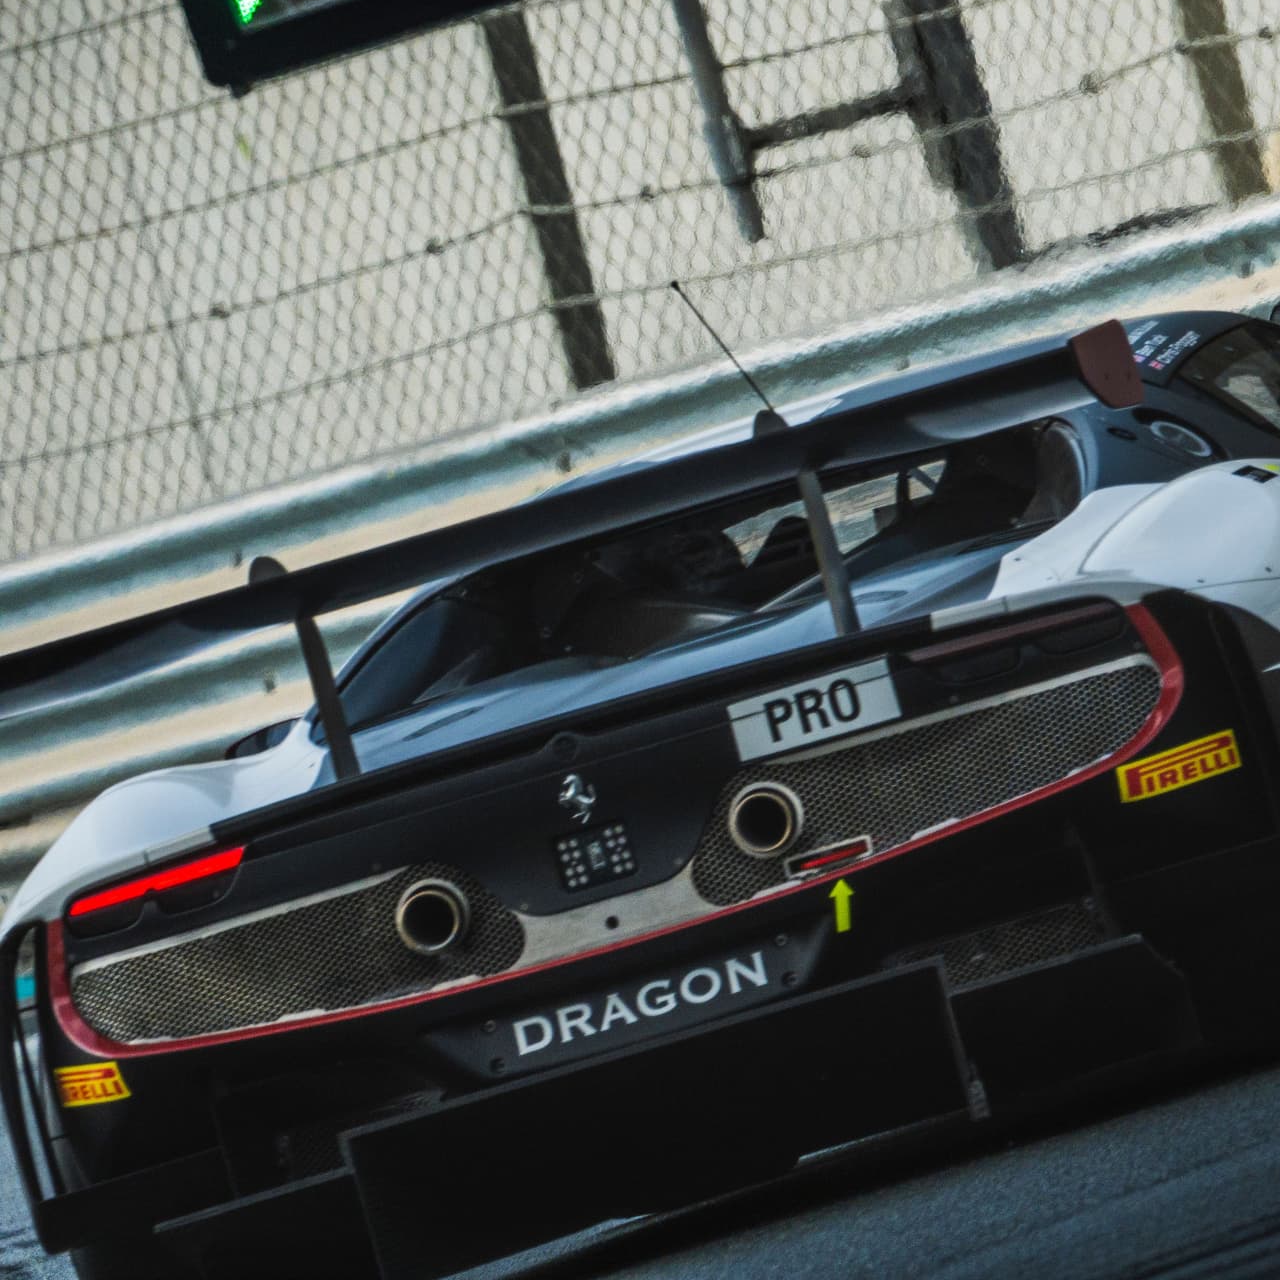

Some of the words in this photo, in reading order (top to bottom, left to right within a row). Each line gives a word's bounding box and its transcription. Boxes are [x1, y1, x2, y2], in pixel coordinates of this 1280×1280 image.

[762, 677, 861, 743] PRO
[1125, 735, 1237, 799] PIRELLI
[511, 951, 769, 1057] DRAGON
